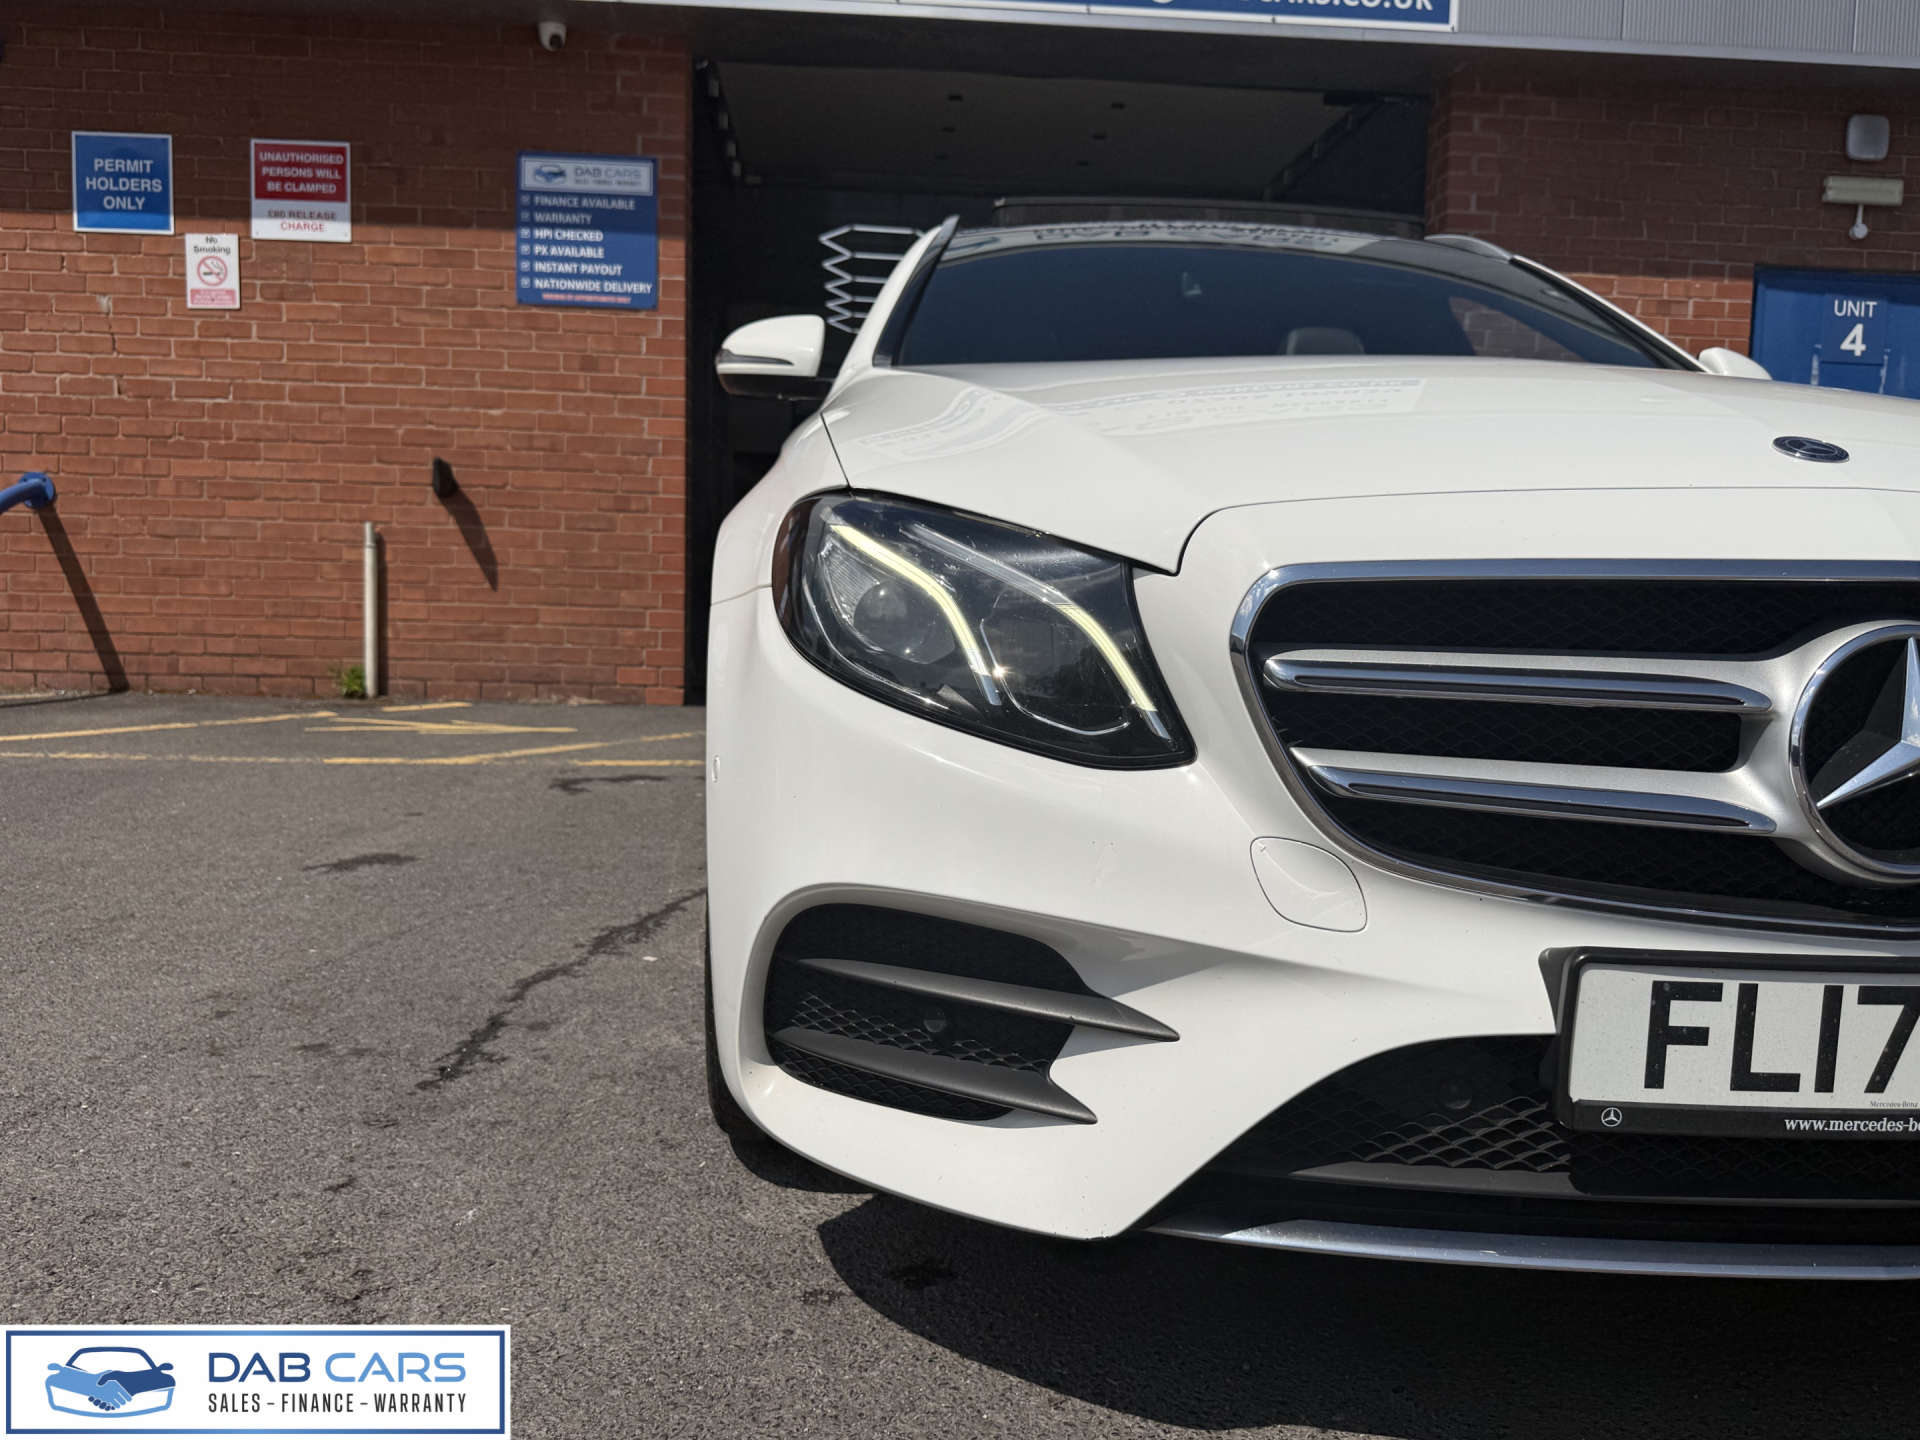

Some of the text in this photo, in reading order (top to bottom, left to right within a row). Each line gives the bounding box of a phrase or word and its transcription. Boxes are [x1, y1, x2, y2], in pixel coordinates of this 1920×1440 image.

[94, 158, 153, 173] PERMIT
[259, 152, 344, 165] UNAUTHORISED
[262, 166, 342, 179] PERSONS WILL
[85, 176, 162, 193] HOLDERS
[266, 181, 337, 194] BE CLAMPED
[103, 195, 145, 211] ONLY
[534, 195, 636, 210] FINANCE AVAILABLE
[288, 209, 337, 220] RELEASE
[534, 212, 592, 225] WARRANTY
[280, 221, 325, 232] CHARGE
[205, 235, 218, 244] No
[534, 228, 604, 242] HPI CHECKED
[193, 245, 231, 256] Smoking
[534, 245, 605, 258] PX AVAILABLE
[534, 261, 623, 276] INSTANT PAYOUT
[534, 278, 653, 294] NATIONWIDE DELIVERY
[1834, 299, 1877, 318] UNIT
[1840, 323, 1867, 357] 4
[1644, 980, 1920, 1094] FL17
[1784, 1117, 1920, 1132] www.mercedes-b
